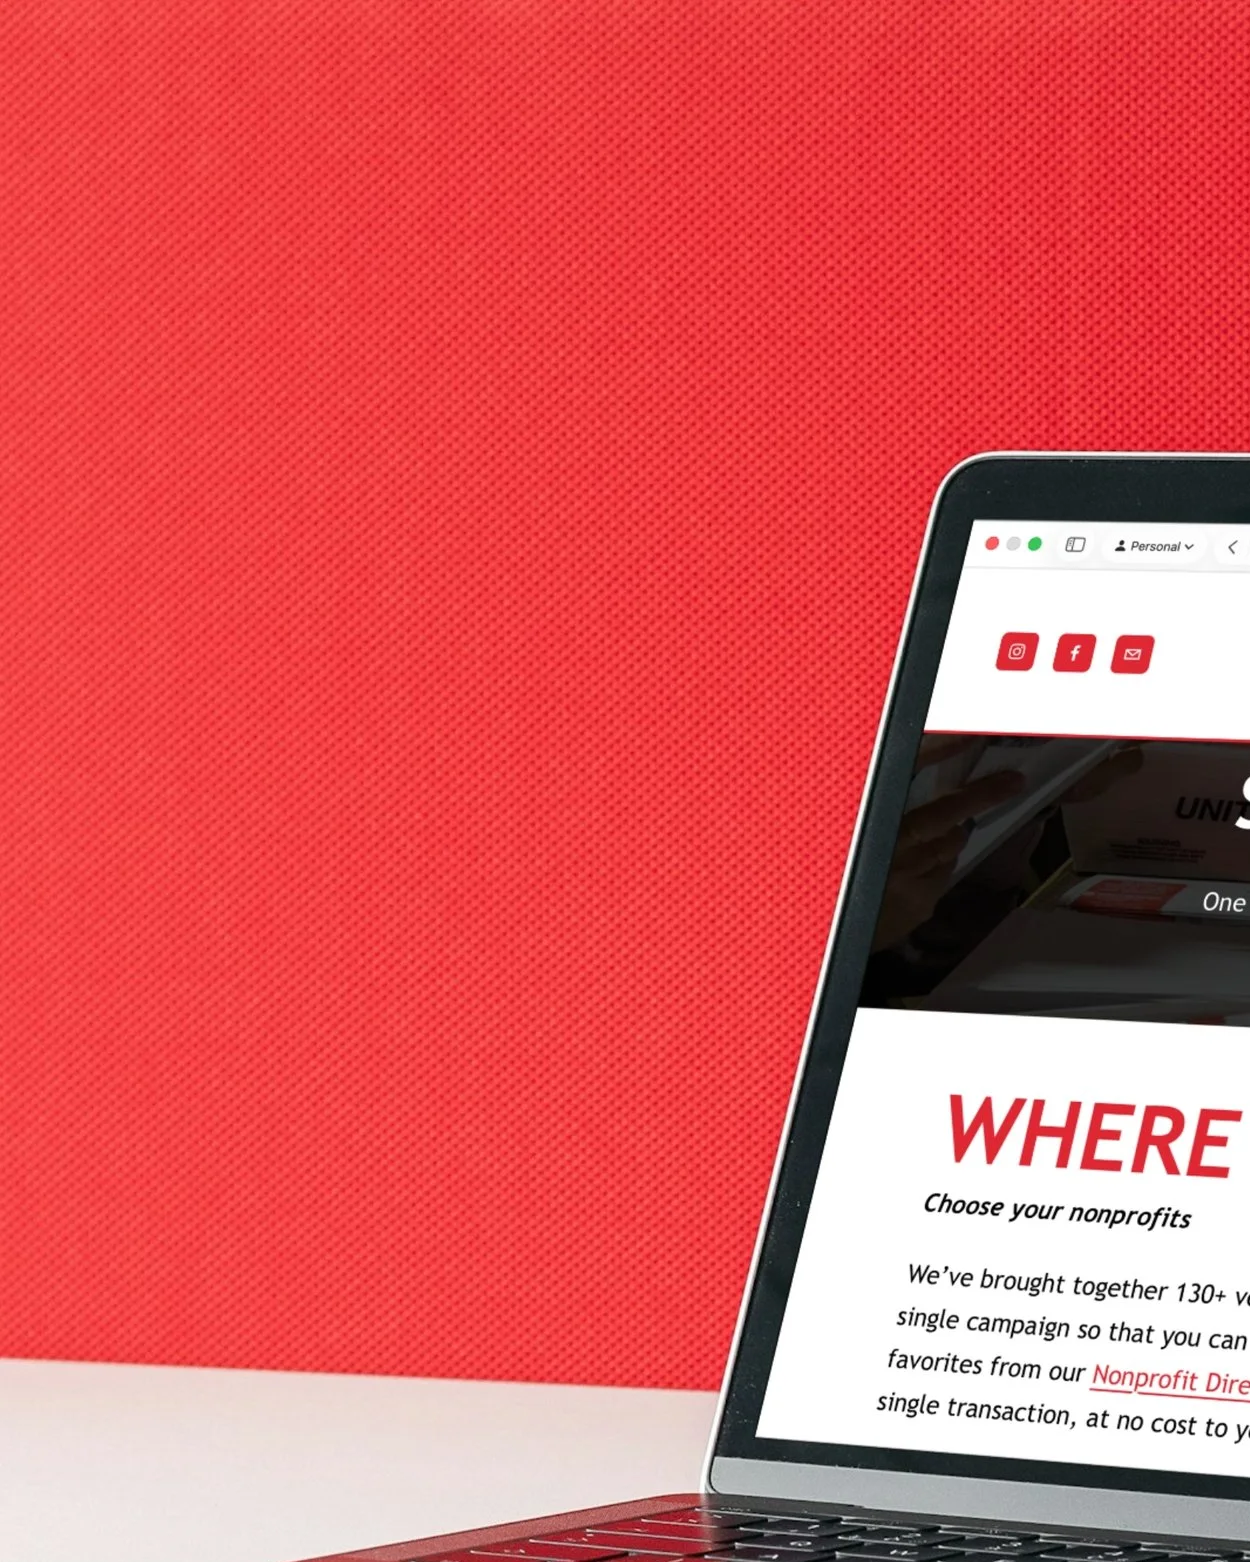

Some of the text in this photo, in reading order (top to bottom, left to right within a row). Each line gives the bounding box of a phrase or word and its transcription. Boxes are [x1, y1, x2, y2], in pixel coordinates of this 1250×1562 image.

[1130, 540, 1181, 552] Personal
[1203, 891, 1247, 913] One
[949, 1094, 1243, 1179] WHERE
[924, 1192, 1193, 1232] Choose your nonprofits
[909, 1263, 974, 1288] We’ve
[980, 1268, 1066, 1297] brought
[1073, 1276, 1169, 1302] together
[1177, 1282, 1226, 1304] 130+
[896, 1308, 960, 1333] single
[966, 1315, 1070, 1342] campaign
[1077, 1323, 1101, 1340] so
[1109, 1321, 1155, 1344] that
[1160, 1330, 1202, 1350] you
[1208, 1333, 1248, 1351] can
[888, 1348, 983, 1375] favorites
[990, 1355, 1042, 1380] from
[1048, 1365, 1087, 1382] our
[1093, 1364, 1198, 1392] Nonprofit
[876, 1393, 940, 1419] single
[948, 1398, 1076, 1430] transaction,
[1086, 1410, 1110, 1429] at
[1116, 1414, 1144, 1431] no
[1150, 1416, 1198, 1436] cost
[1205, 1418, 1228, 1438] to
